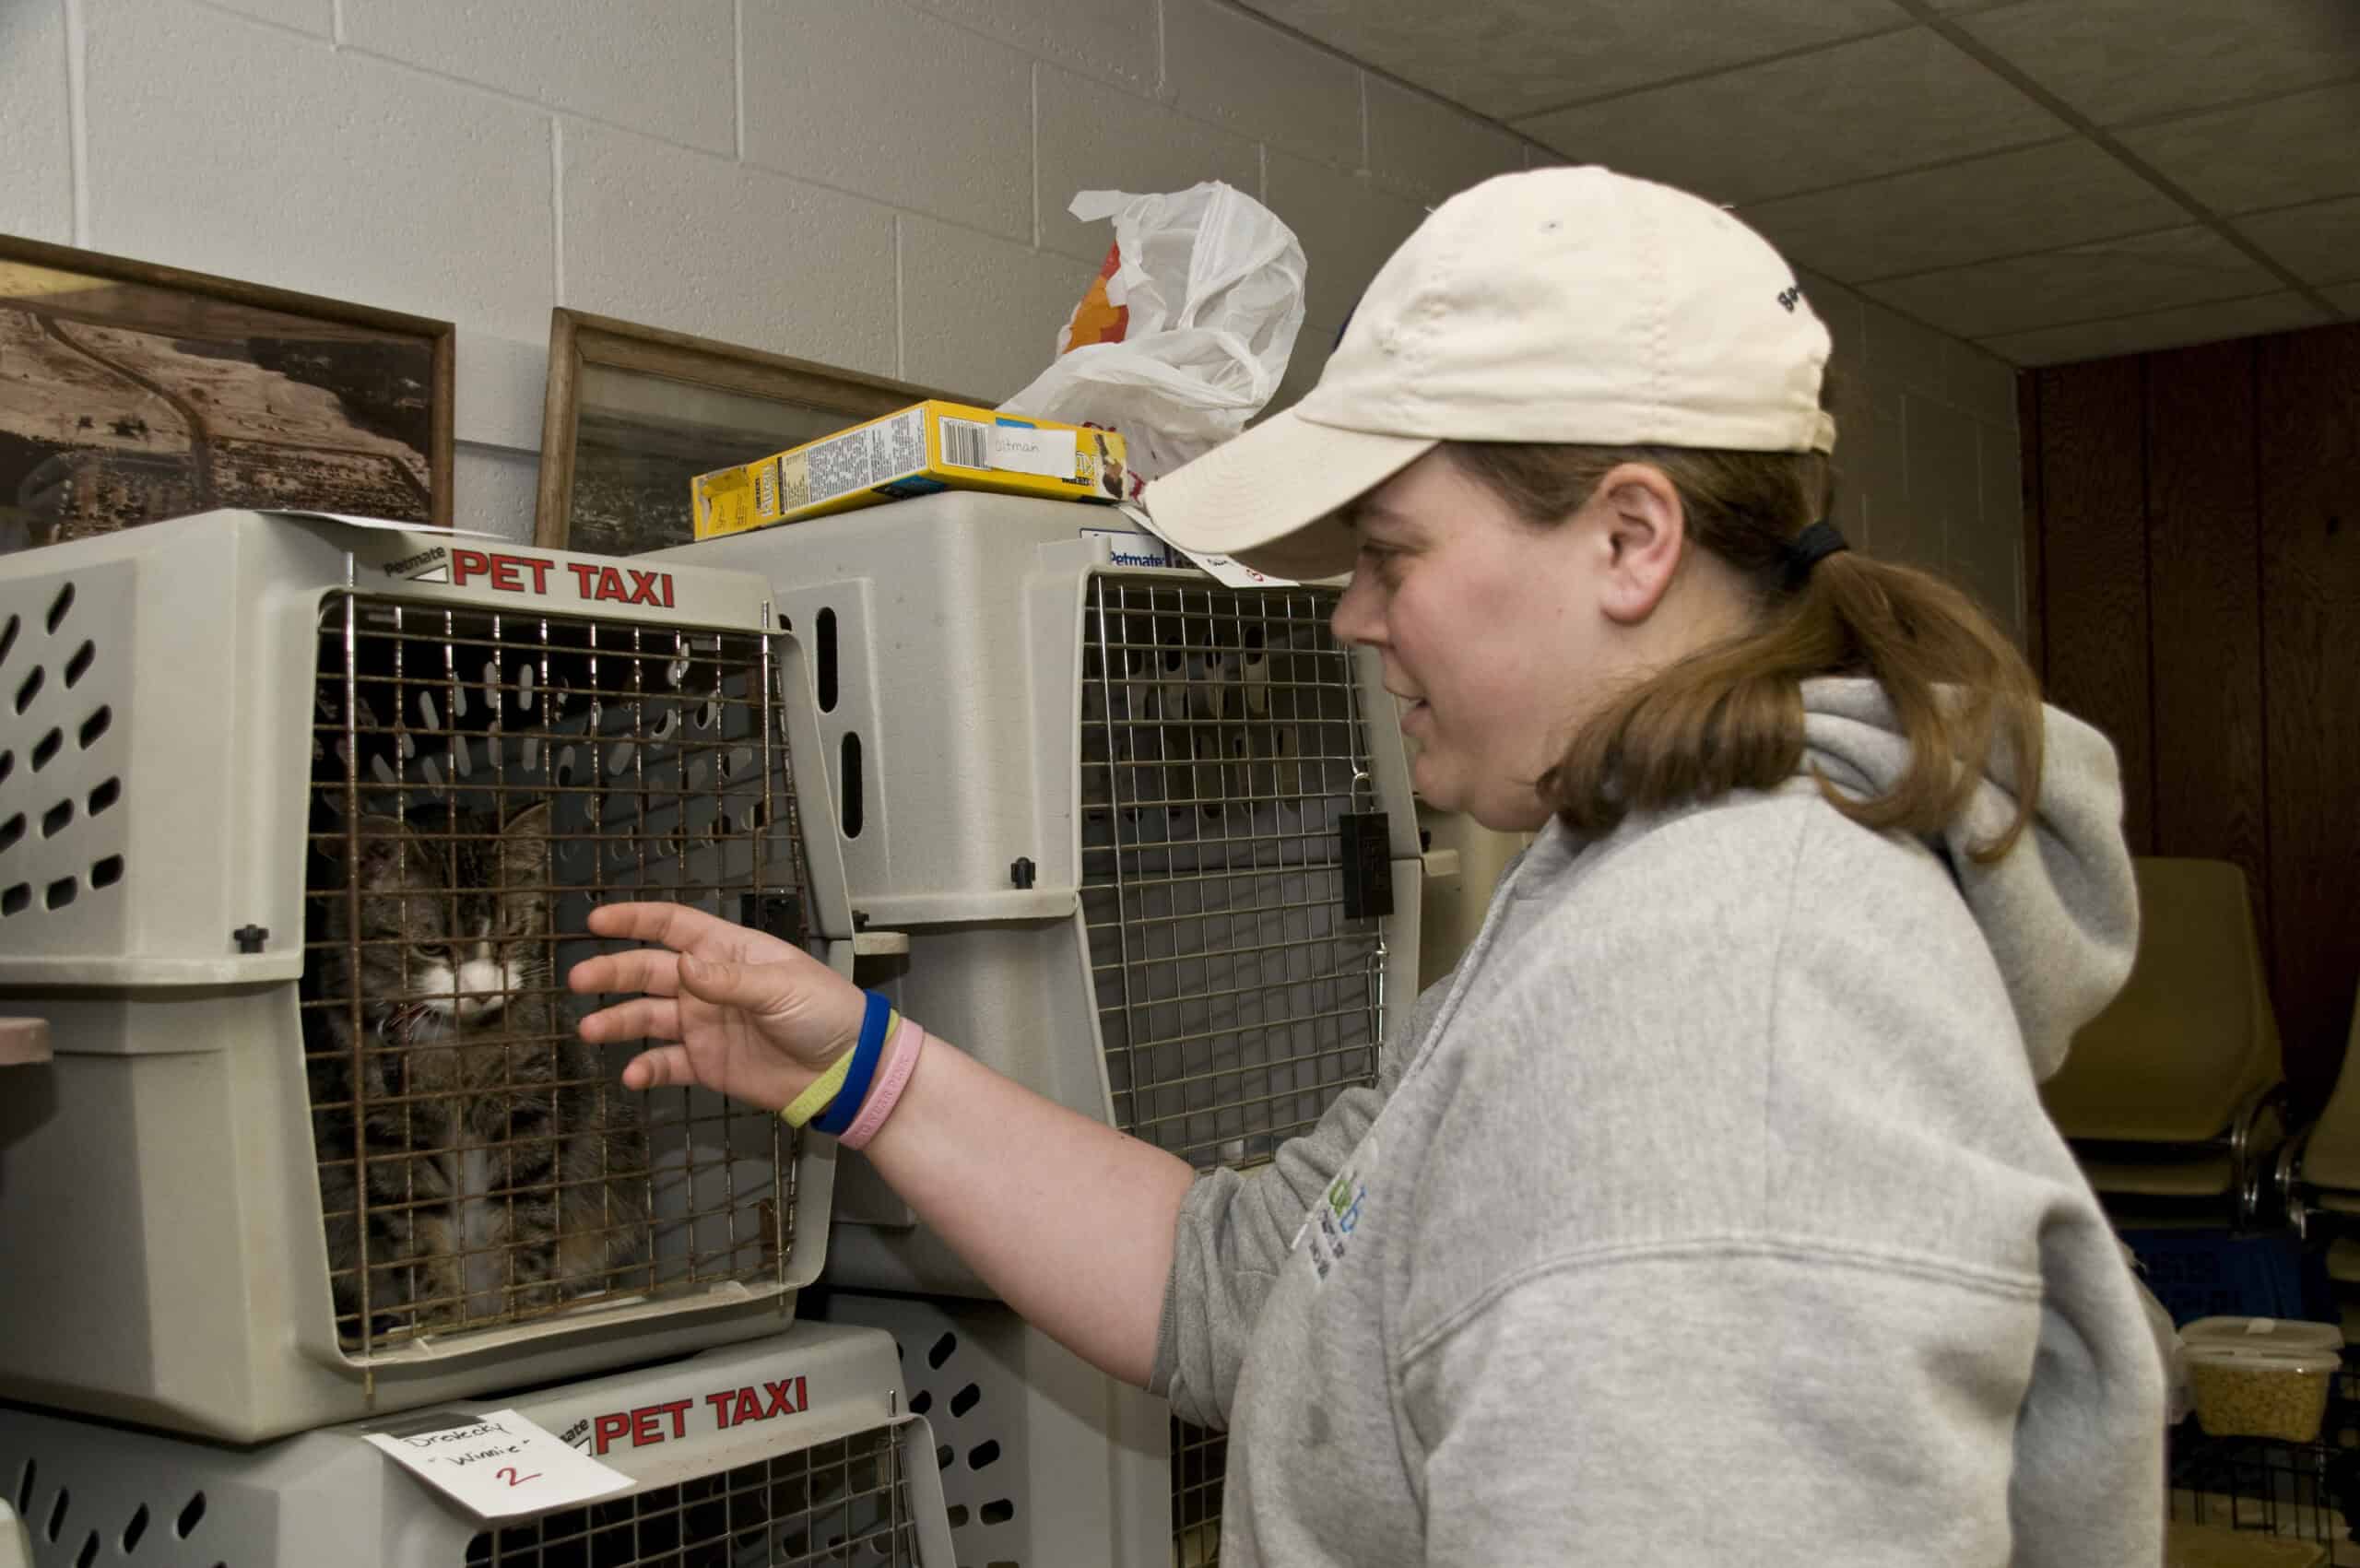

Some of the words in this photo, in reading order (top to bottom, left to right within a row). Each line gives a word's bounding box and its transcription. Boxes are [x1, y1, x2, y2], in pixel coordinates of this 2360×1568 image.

[383, 547, 446, 578] Petmate
[452, 548, 555, 595] PET
[567, 562, 676, 608] TAXI
[595, 1398, 693, 1456] PET
[706, 1375, 809, 1430] TAXI
[495, 1467, 544, 1487] 2
